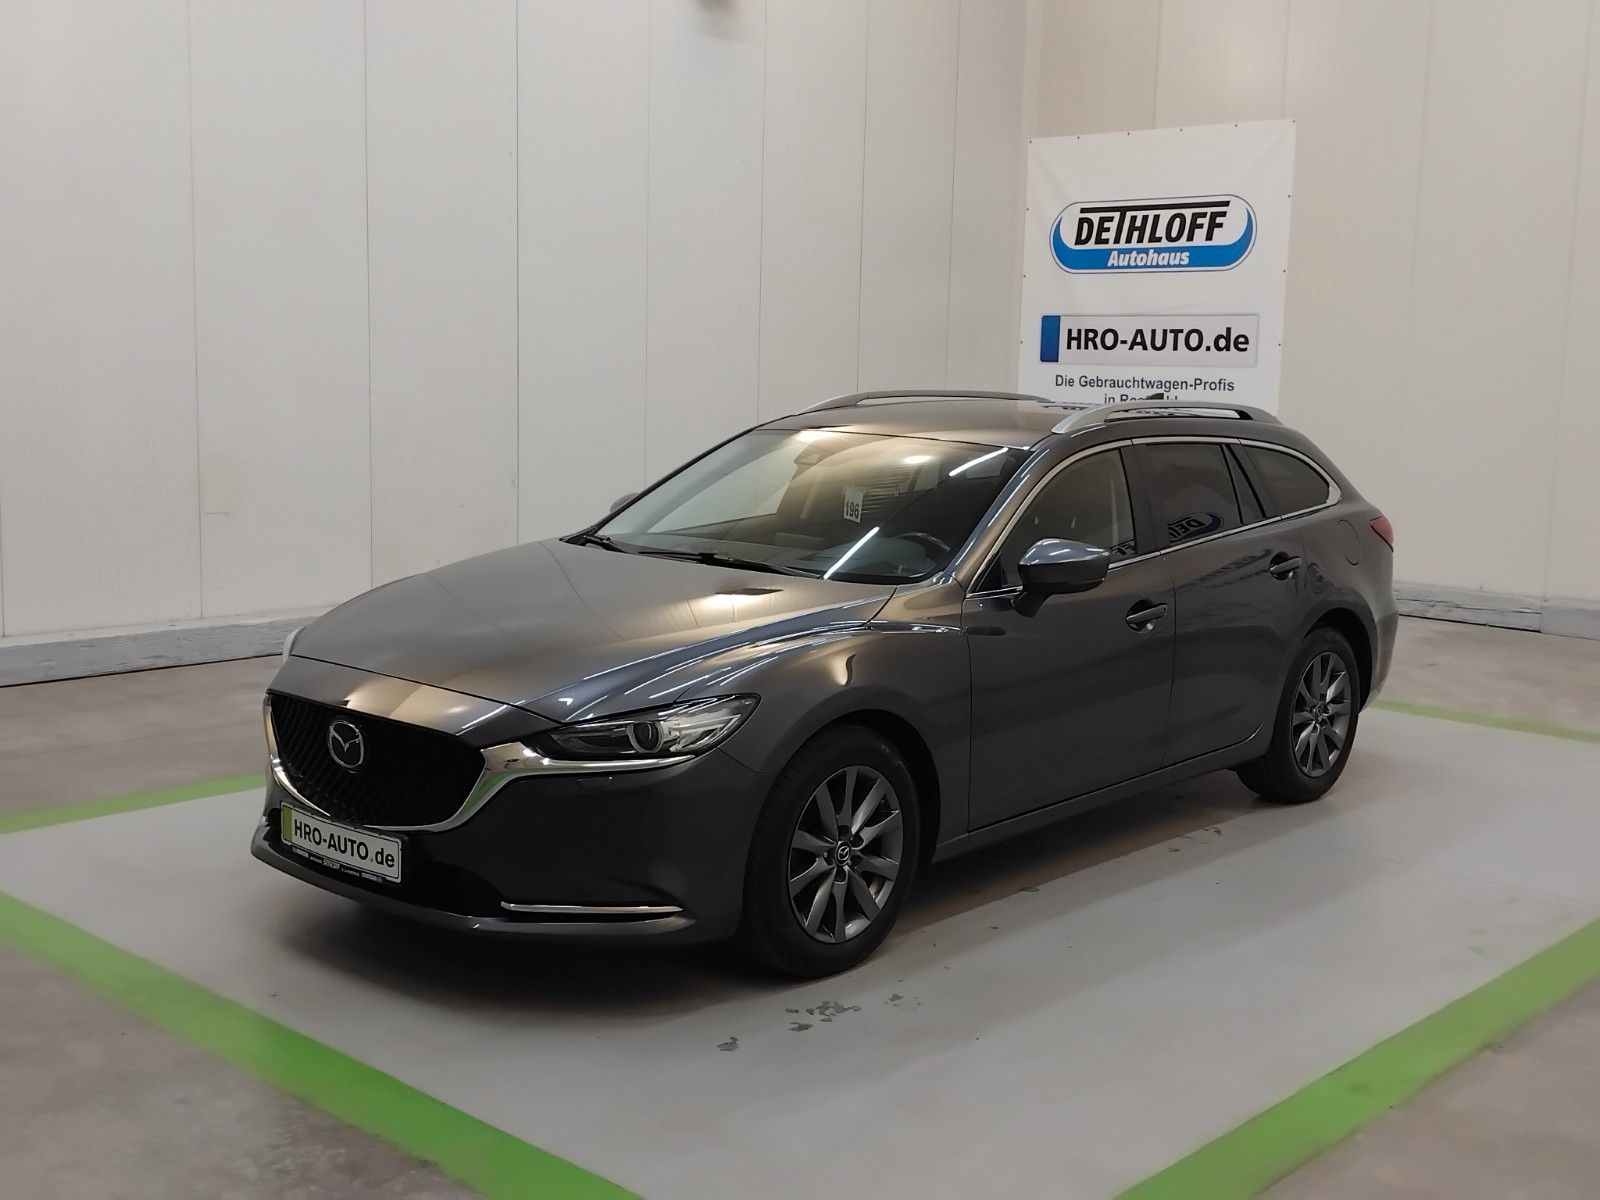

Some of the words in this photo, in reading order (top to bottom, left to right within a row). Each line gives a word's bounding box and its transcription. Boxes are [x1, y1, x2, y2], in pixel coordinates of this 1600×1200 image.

[1074, 200, 1231, 246] DETHLOFF
[1107, 249, 1190, 267] Autohaus
[1066, 327, 1250, 352] HRO-AUTO.de
[1055, 374, 1075, 387] Die
[1078, 375, 1235, 393] Gebrauchtwagen-Profis
[1104, 393, 1116, 404] in
[845, 500, 860, 519] 196
[294, 819, 395, 868] HRO-AUTO.de
